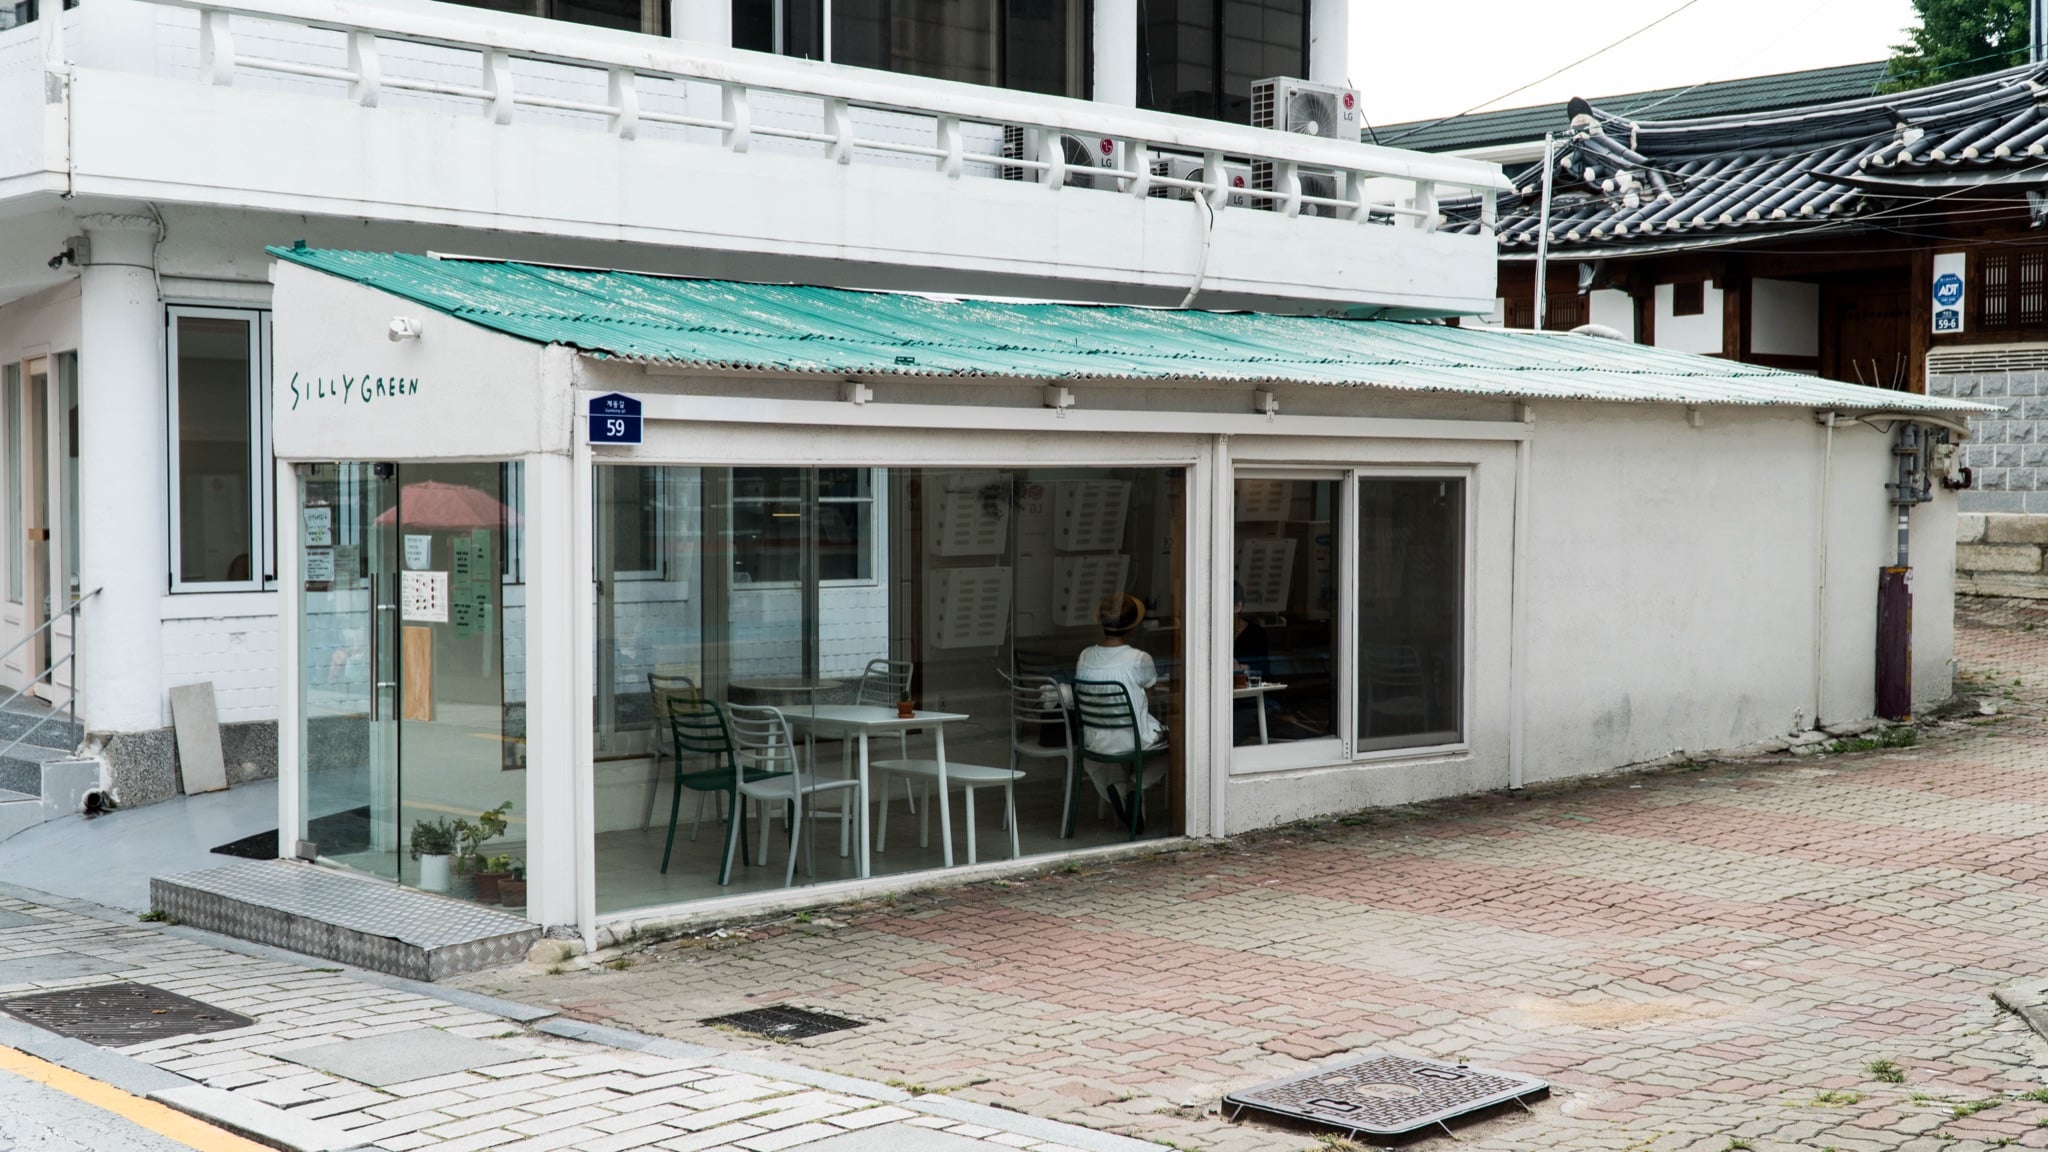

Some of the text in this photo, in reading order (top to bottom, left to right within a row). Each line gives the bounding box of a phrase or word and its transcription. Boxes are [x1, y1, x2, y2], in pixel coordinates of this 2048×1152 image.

[1343, 112, 1353, 121] LG
[1101, 157, 1112, 168] LG
[1233, 195, 1244, 205] LG
[1938, 284, 1958, 296] ADT
[1938, 318, 1956, 328] 59-6
[290, 371, 419, 411] SILLY GREEN
[606, 419, 625, 436] 59
